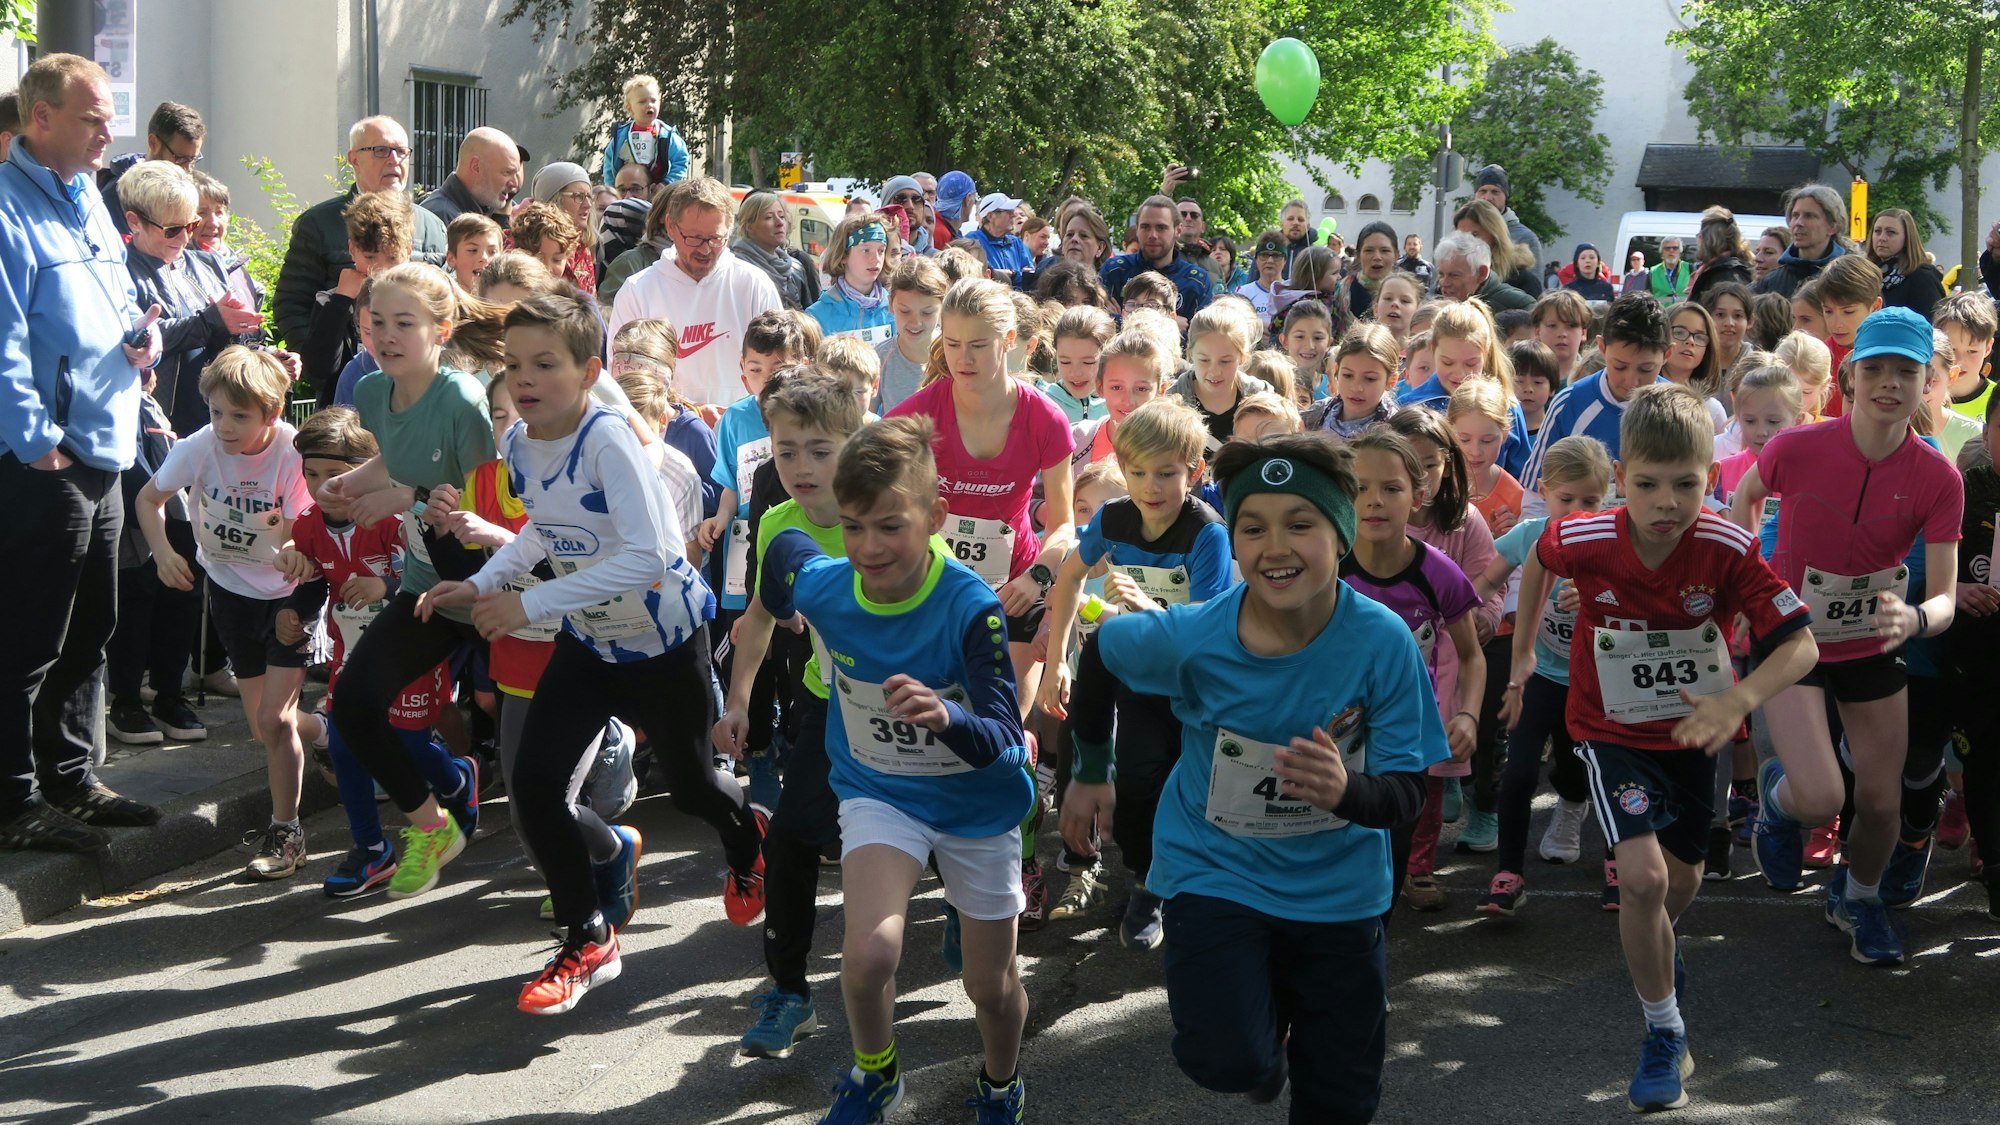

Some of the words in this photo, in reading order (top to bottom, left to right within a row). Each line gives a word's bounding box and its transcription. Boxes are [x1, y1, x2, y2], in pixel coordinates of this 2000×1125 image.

[681, 321, 715, 344] NIKE
[953, 480, 1016, 494] bunert
[213, 523, 257, 546] 467
[552, 537, 587, 552] KÖLN
[1826, 596, 1879, 620] 841
[830, 649, 855, 667] JAKO
[1632, 659, 1699, 689] 843
[402, 693, 429, 707] LSC
[402, 708, 429, 718] VEREIN
[869, 717, 935, 746] 397
